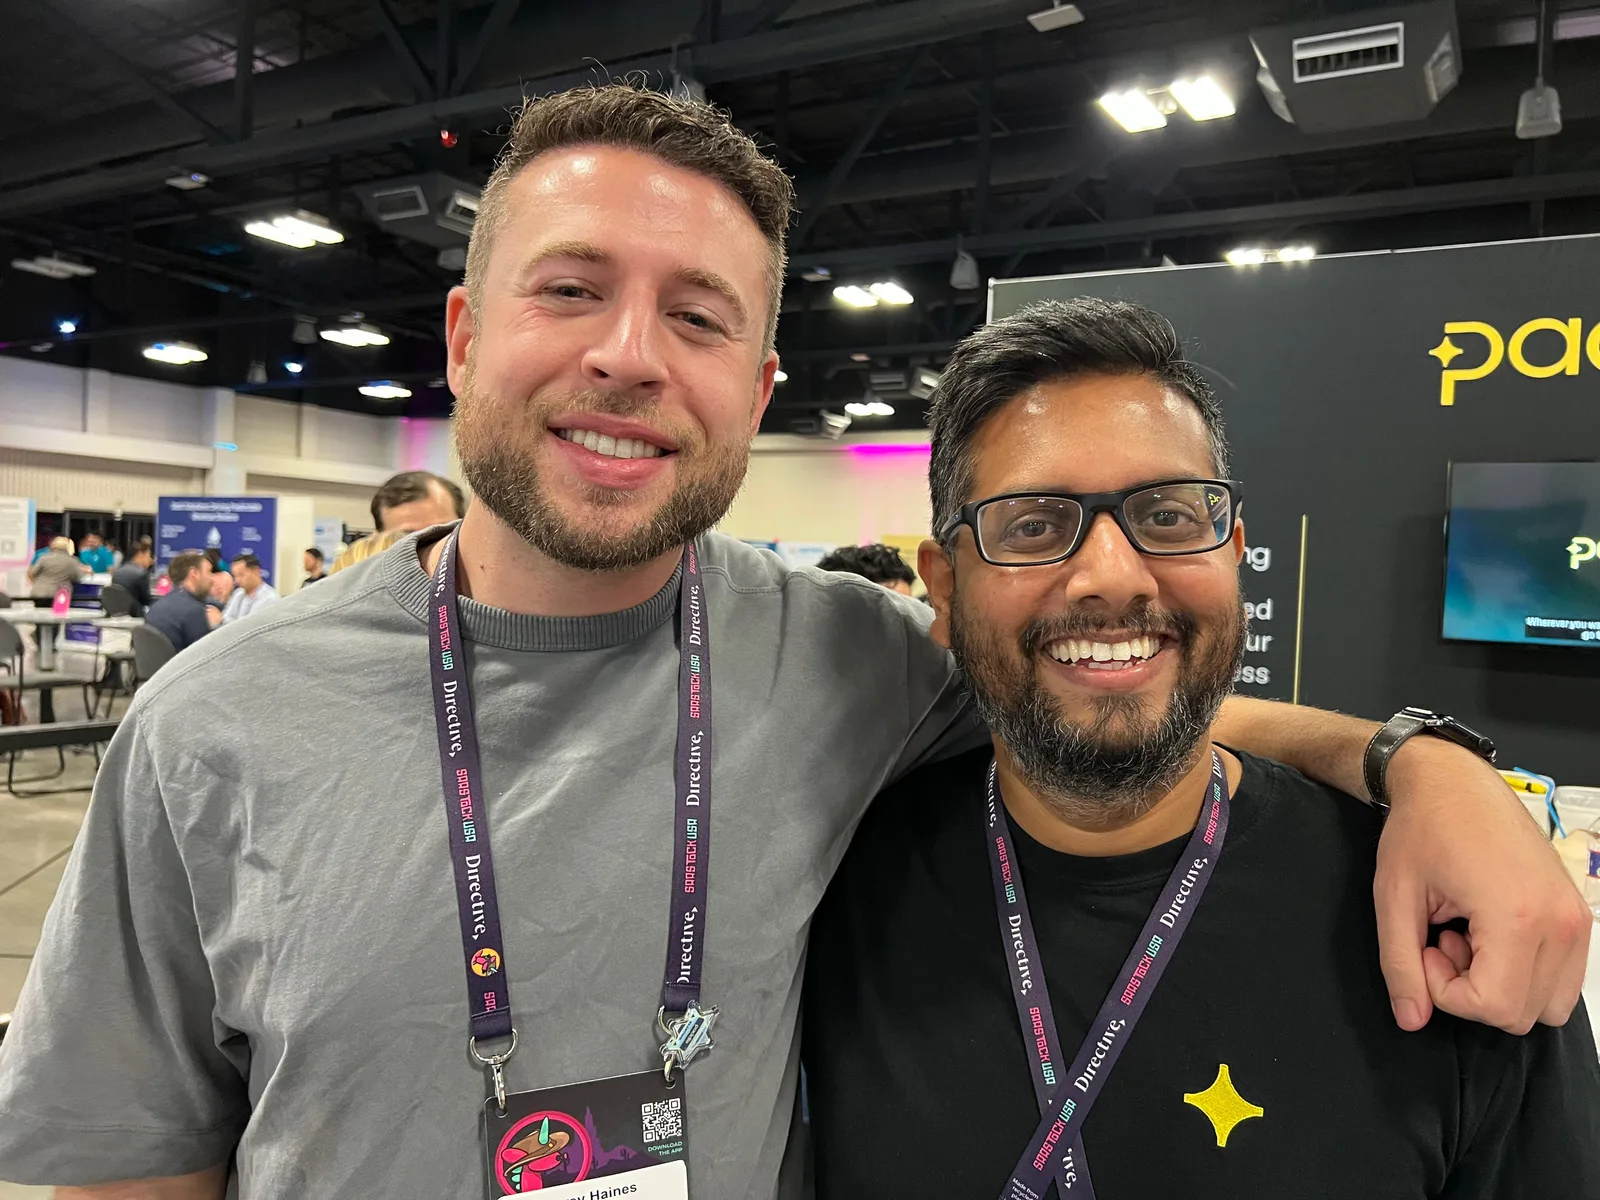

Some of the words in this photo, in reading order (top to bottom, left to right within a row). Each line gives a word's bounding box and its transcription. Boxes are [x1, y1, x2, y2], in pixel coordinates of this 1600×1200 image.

[689, 585, 700, 646] Directive,
[443, 680, 463, 757] Directive,
[686, 730, 704, 807] Directive,
[465, 854, 486, 940] Directive,
[1159, 857, 1208, 928] Directive,
[1008, 914, 1033, 996] Directive,
[1073, 1019, 1126, 1092] Directive,
[647, 1141, 683, 1152] DOWNLOAD
[590, 1184, 637, 1200] Haines
[1012, 1177, 1026, 1190] Made
[1027, 1188, 1039, 1199] from
